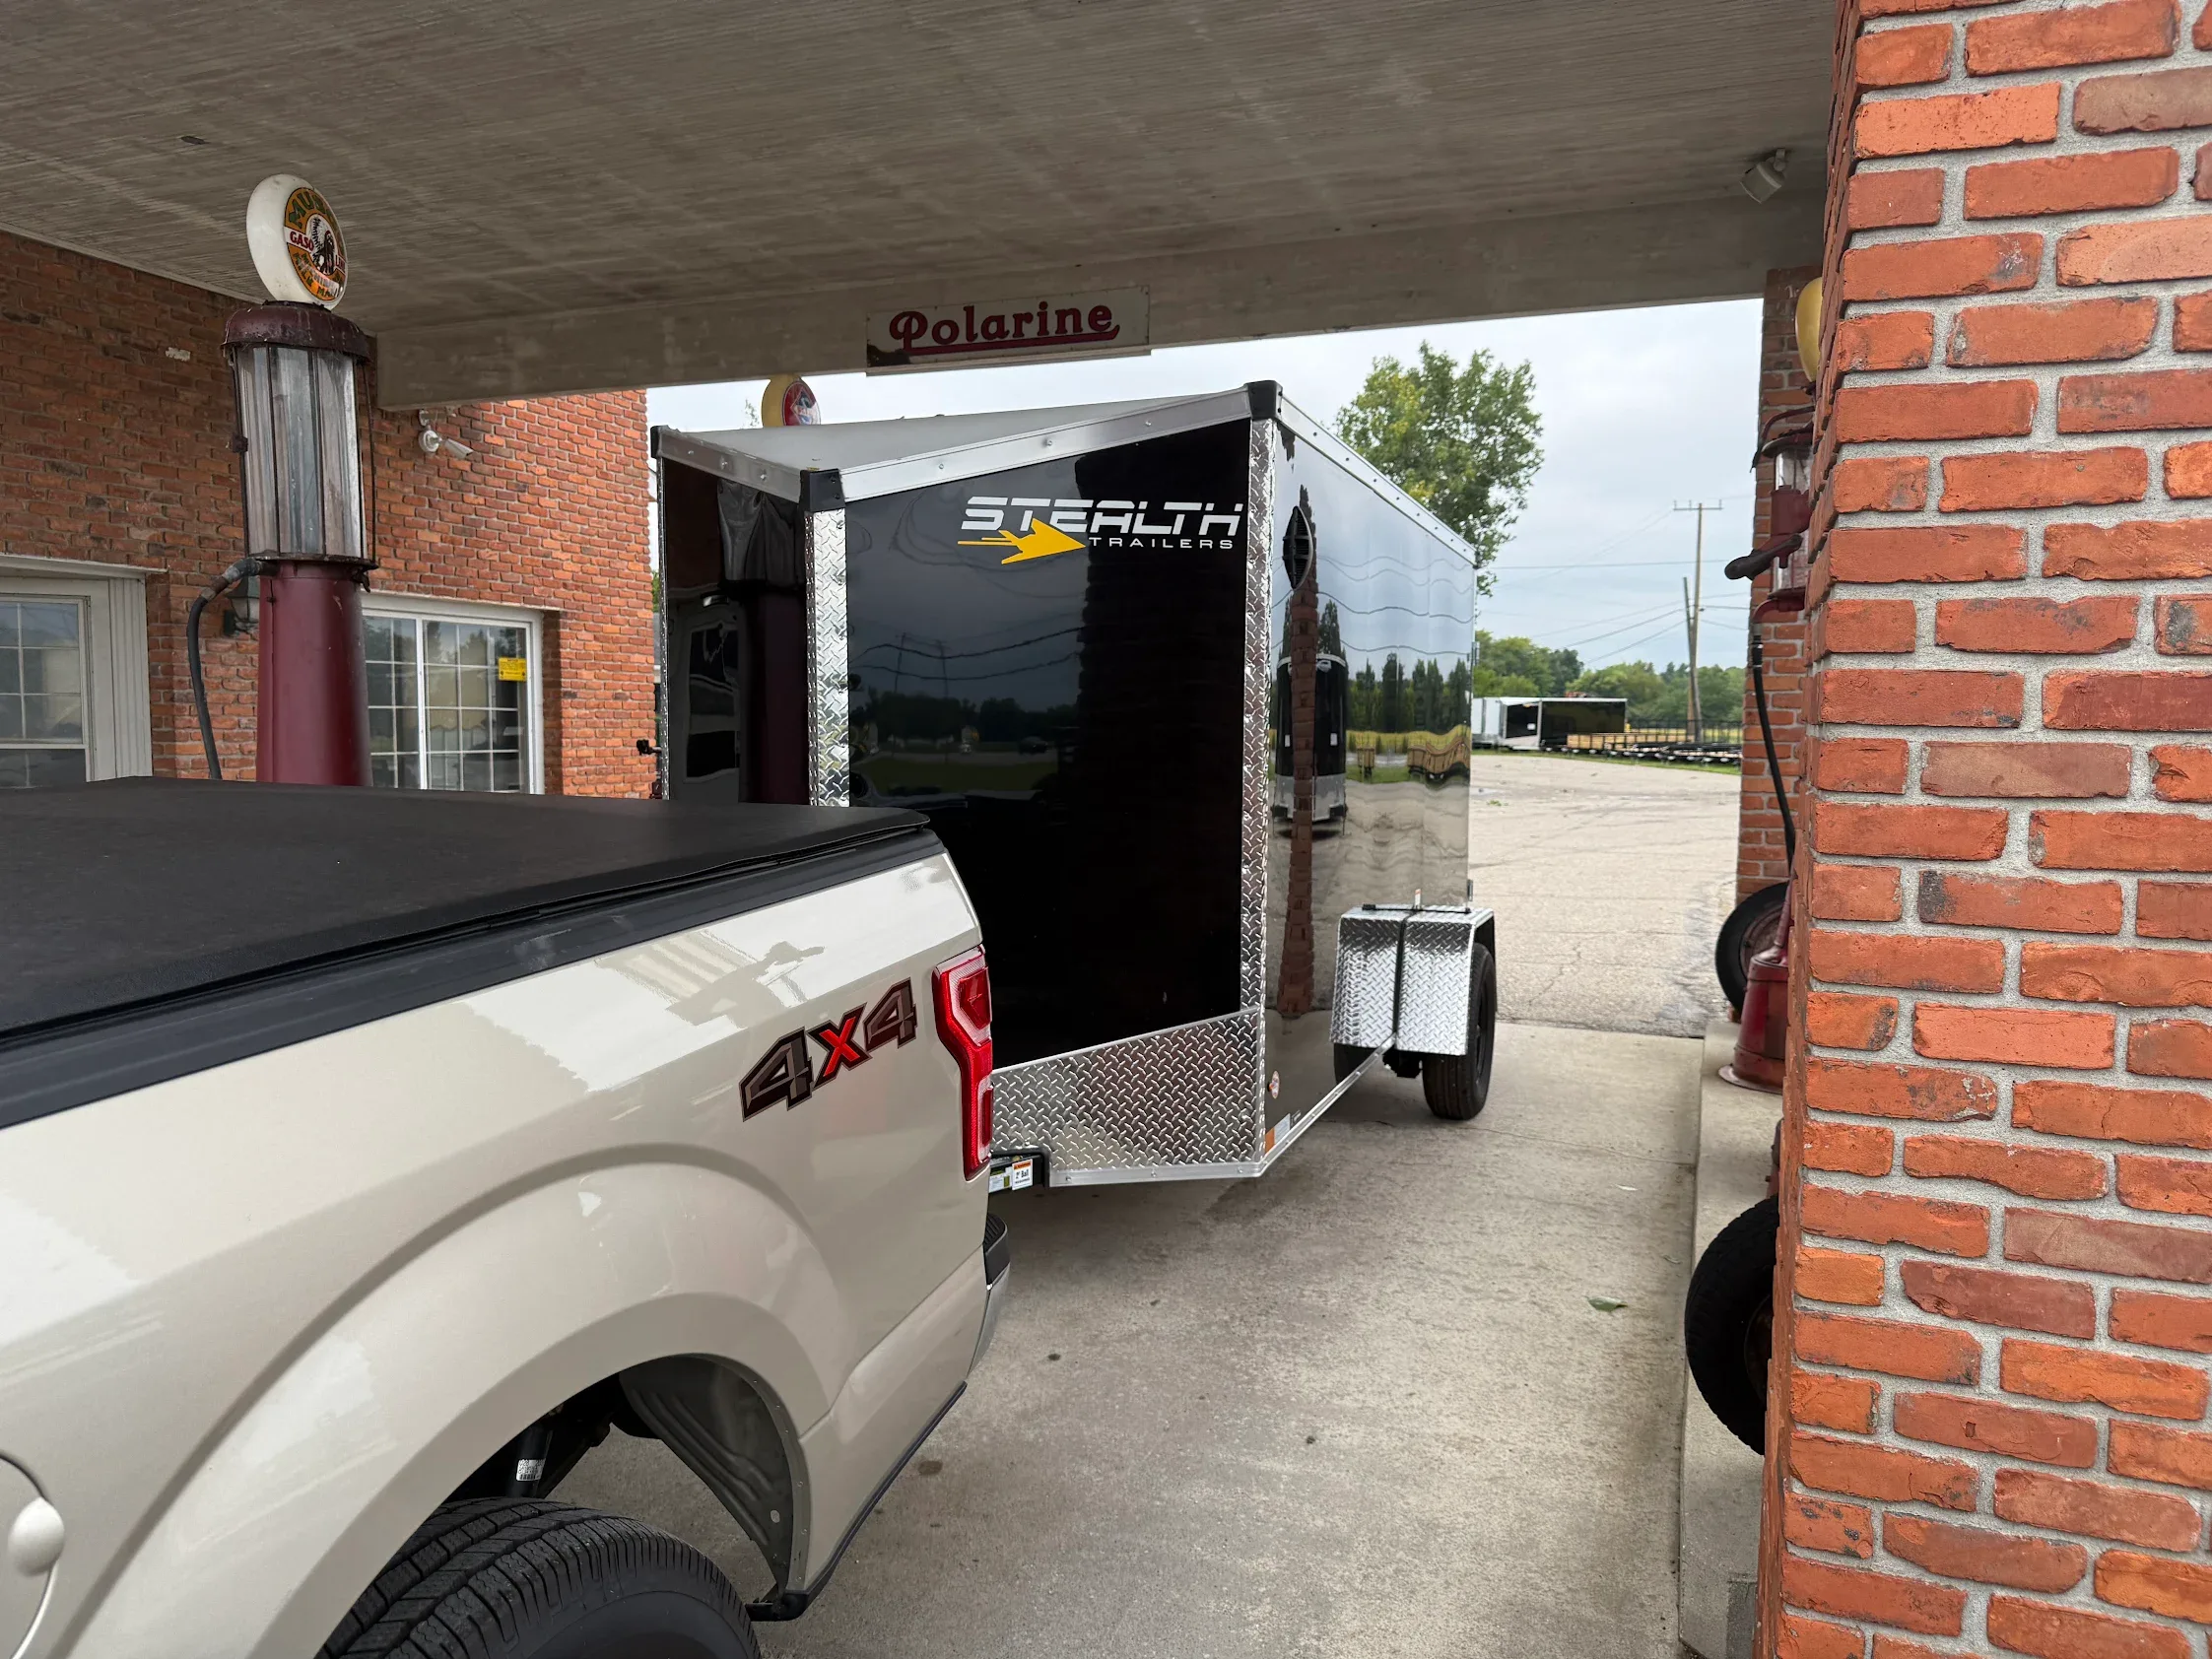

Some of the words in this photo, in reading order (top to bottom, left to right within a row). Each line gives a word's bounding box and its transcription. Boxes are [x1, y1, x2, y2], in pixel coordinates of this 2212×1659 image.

[289, 231, 314, 251] GASO
[889, 300, 1120, 356] Polarine
[961, 496, 1243, 536] STEALTH
[1089, 537, 1234, 550] TRAILERS
